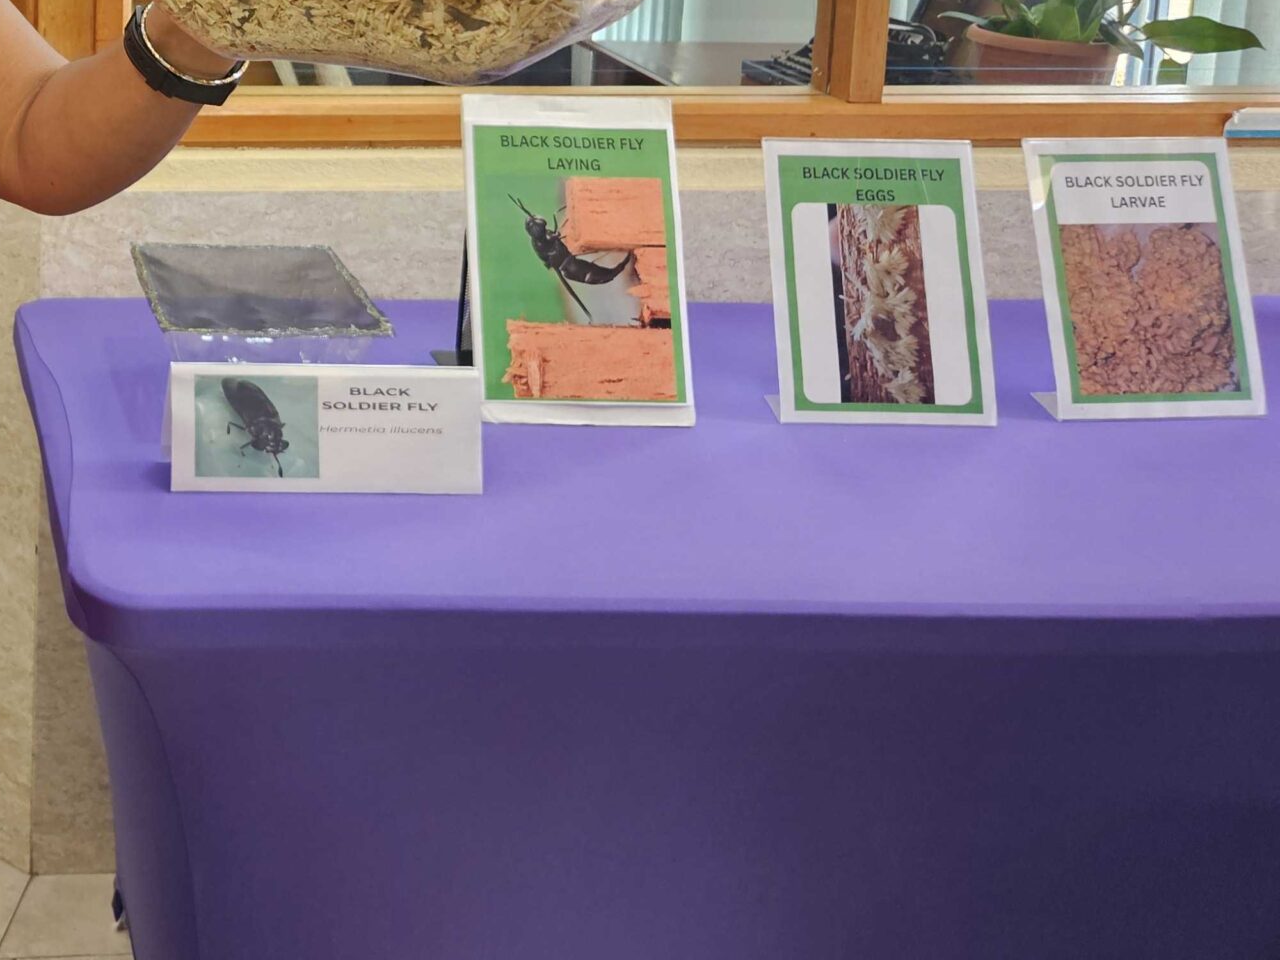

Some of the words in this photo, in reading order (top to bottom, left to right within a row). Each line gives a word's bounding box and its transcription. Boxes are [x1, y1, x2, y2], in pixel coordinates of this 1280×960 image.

[500, 135, 550, 148] BLACK
[553, 135, 616, 150] SOLDIER
[619, 137, 644, 150] FLY
[547, 157, 601, 171] LAYING
[802, 166, 850, 180] BLACK
[854, 167, 917, 181] SOLDIER
[920, 168, 945, 182] FLY
[1065, 175, 1113, 189] BLACK
[1116, 174, 1178, 188] SOLDIER
[1180, 174, 1204, 187] FLY
[856, 189, 895, 202] EGGS
[1110, 196, 1167, 209] LARVAE
[350, 386, 411, 397] BLACK
[322, 401, 402, 412] SOLDIER
[407, 402, 438, 412] FLY
[319, 424, 386, 434] Hermetia
[389, 426, 443, 435] illucens
